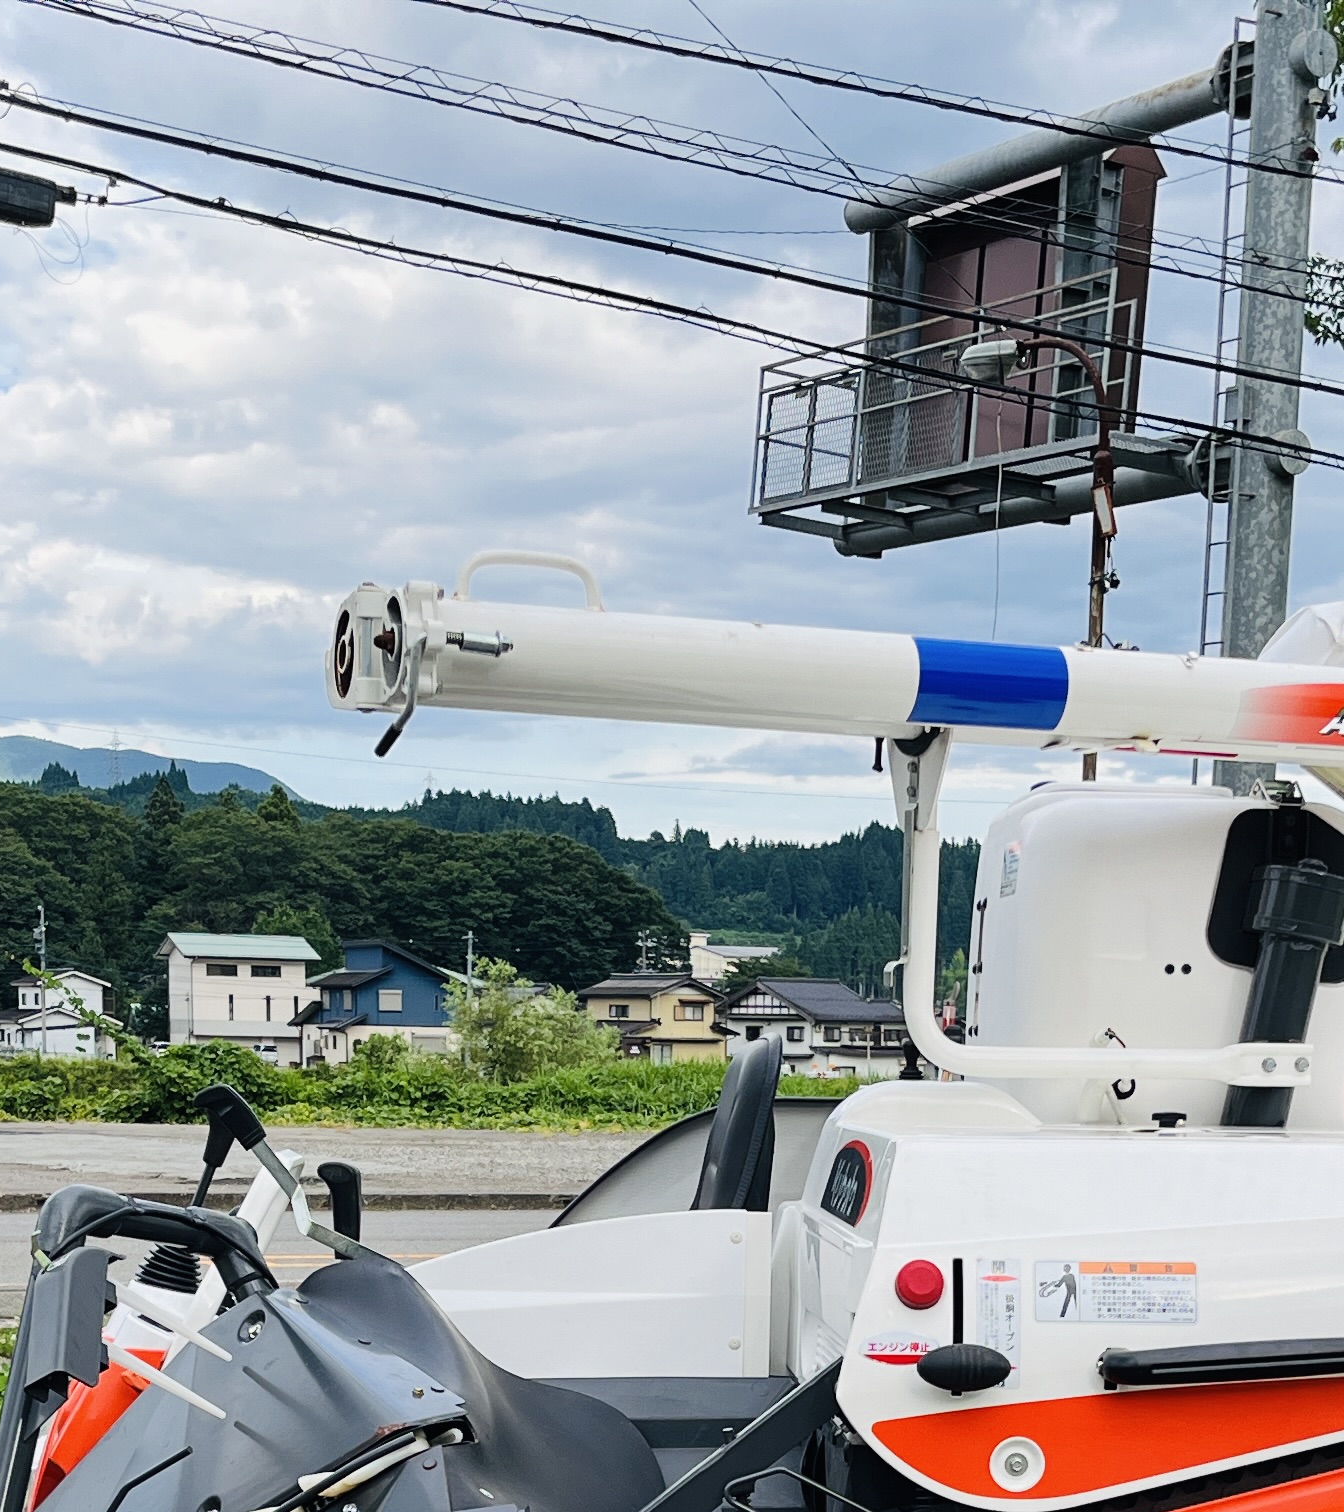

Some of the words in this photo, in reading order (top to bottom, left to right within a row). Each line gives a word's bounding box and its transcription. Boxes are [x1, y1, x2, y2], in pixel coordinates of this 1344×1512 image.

[867, 1342, 930, 1353] エンジン停止
